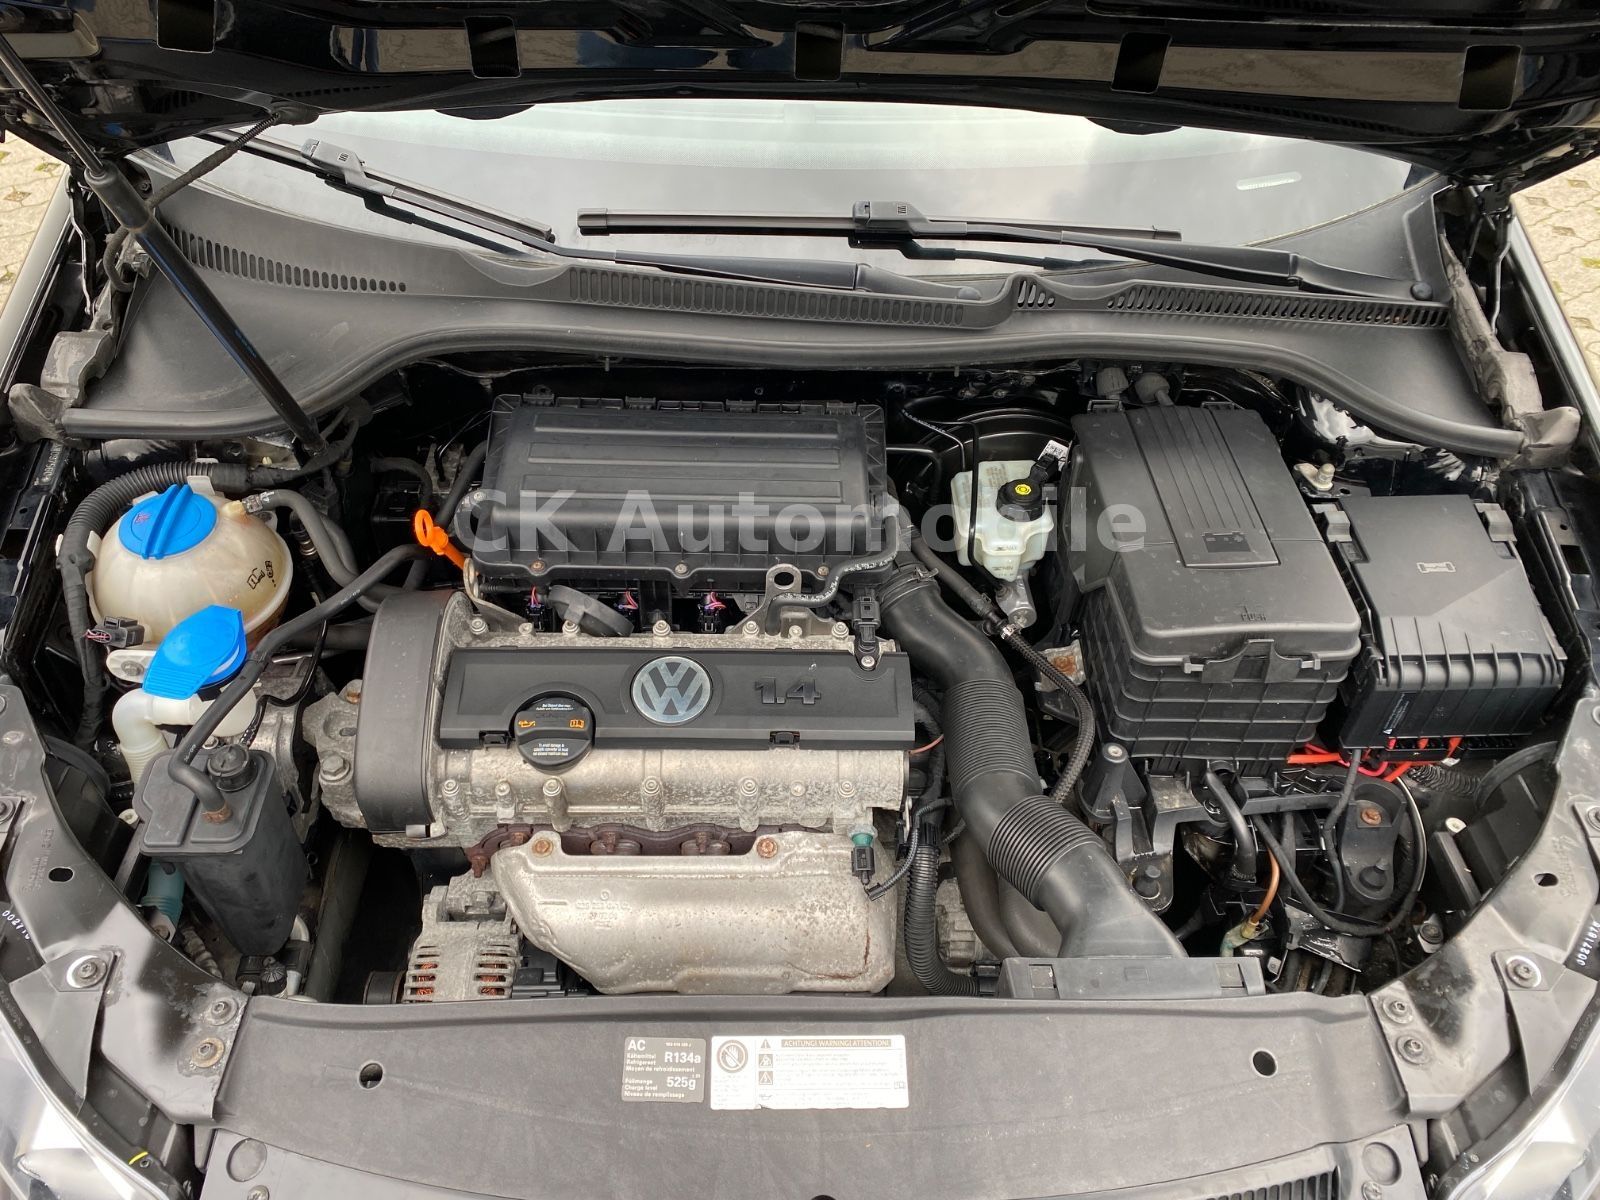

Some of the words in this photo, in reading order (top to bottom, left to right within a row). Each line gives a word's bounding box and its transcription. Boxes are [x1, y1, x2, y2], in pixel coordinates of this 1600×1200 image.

[632, 656, 711, 723] VW
[754, 676, 821, 704] 1.4
[627, 1039, 646, 1051] AC
[664, 1051, 701, 1063] R134a
[666, 1076, 696, 1090] 525g
